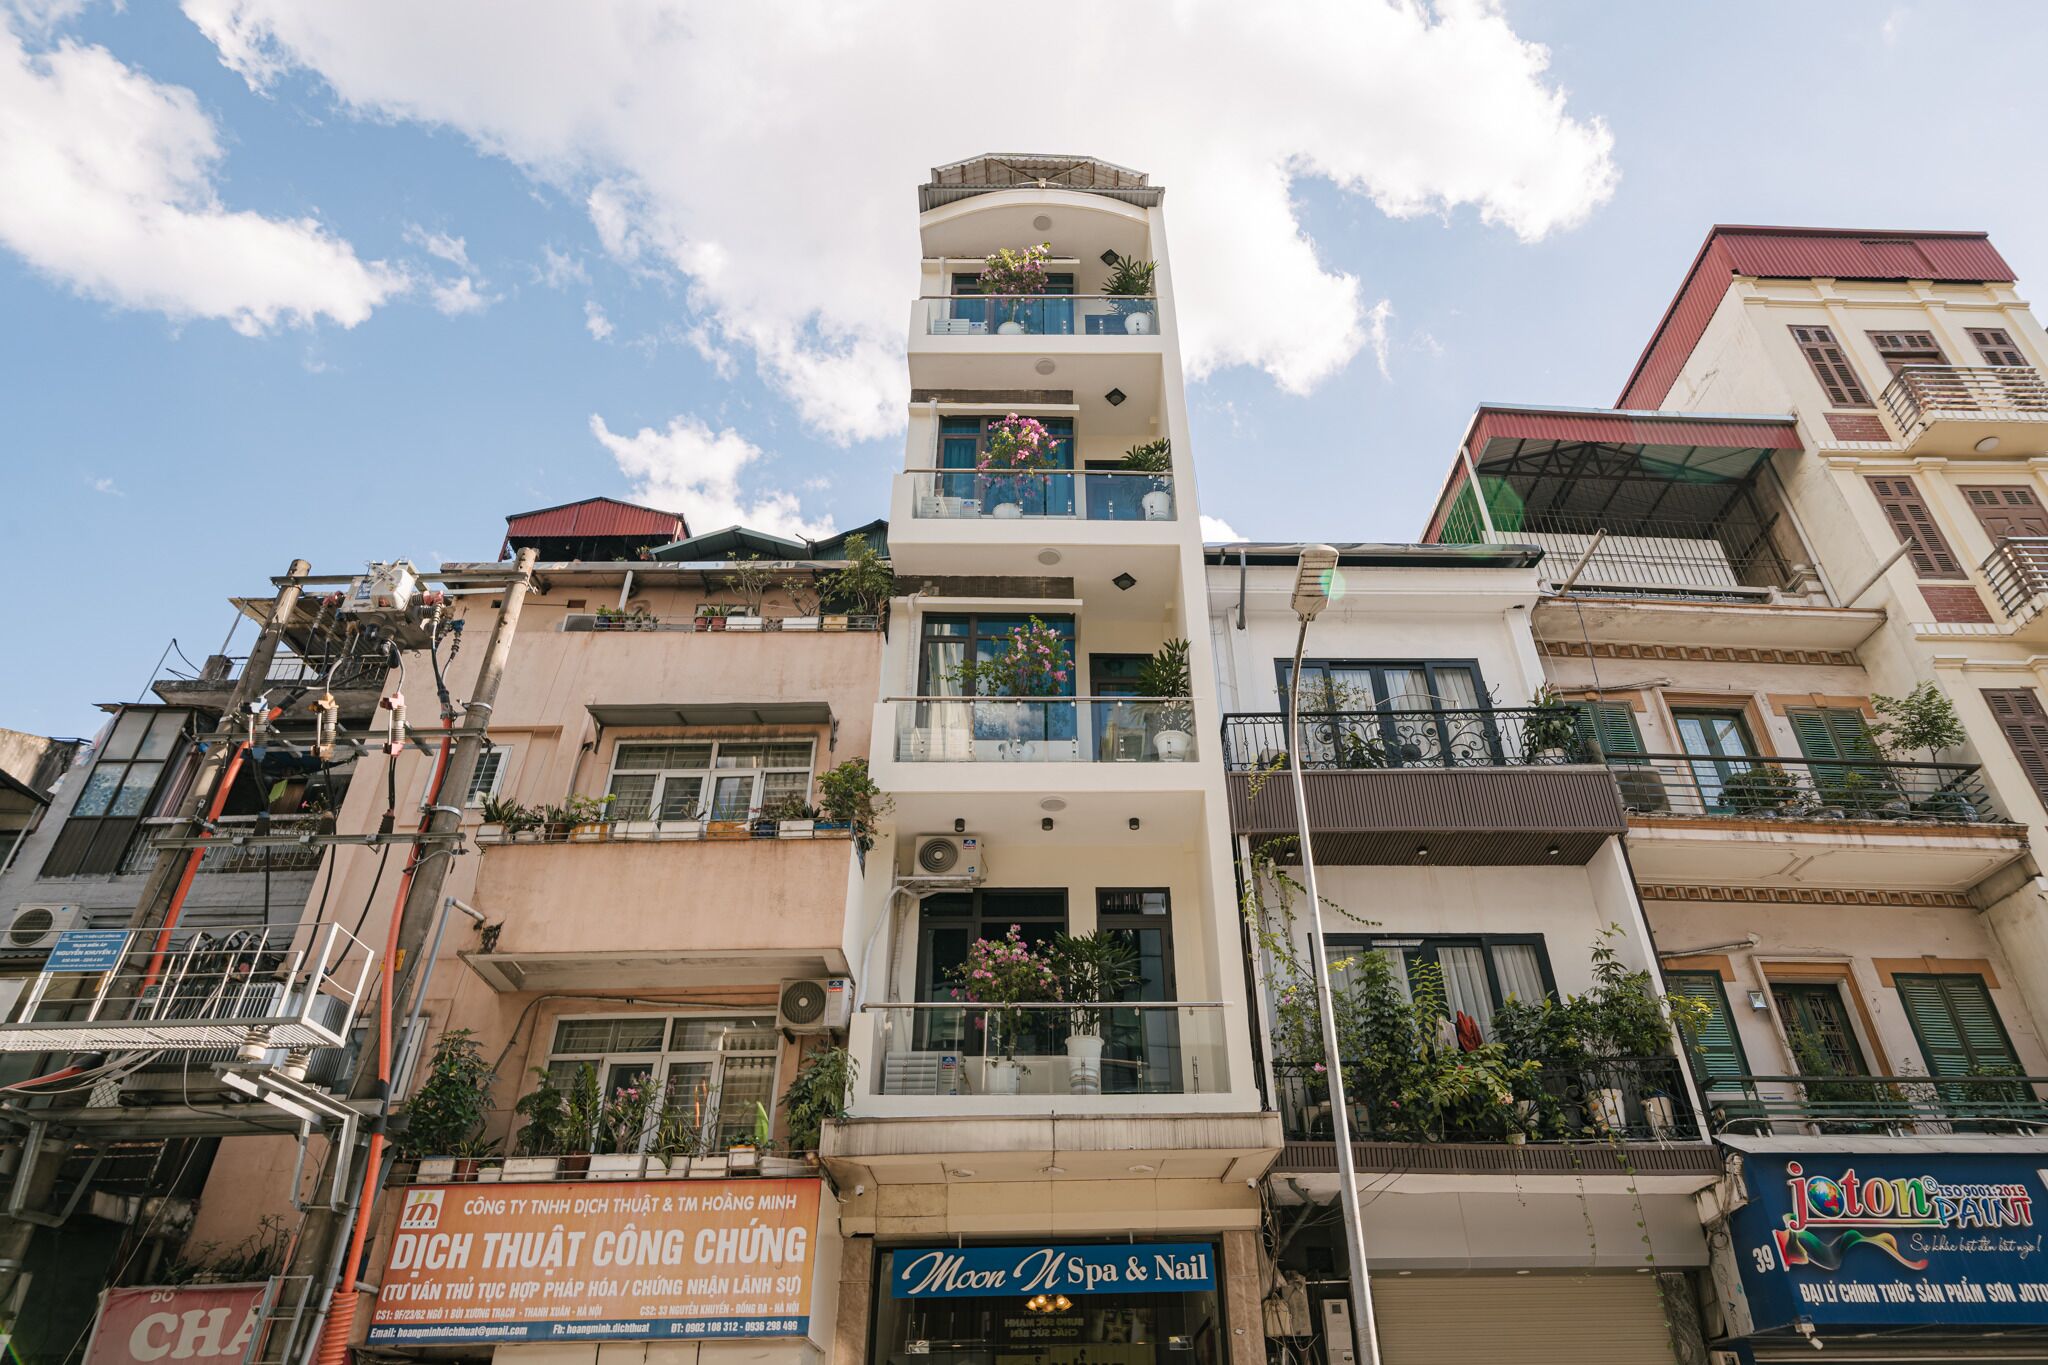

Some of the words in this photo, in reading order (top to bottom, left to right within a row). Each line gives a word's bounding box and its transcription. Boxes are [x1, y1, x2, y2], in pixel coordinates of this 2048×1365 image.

[1940, 1185, 1963, 1197] ISO
[1964, 1184, 2027, 1197] 9001:2015
[464, 1196, 506, 1216] CÔNG
[510, 1200, 527, 1215] TY
[531, 1199, 571, 1215] TNHH
[574, 1198, 609, 1217] DỊCH
[613, 1195, 659, 1216] THUẬT
[662, 1197, 673, 1212] &
[677, 1197, 698, 1212] TM
[702, 1193, 754, 1212] HOÀNG
[758, 1194, 797, 1210] MINH
[1932, 1197, 2034, 1228] PAINT
[390, 1233, 474, 1278] DỊCH
[482, 1224, 586, 1276] THUẬT
[592, 1223, 685, 1267] CÔNG
[693, 1218, 808, 1266] CHỨNG
[1752, 1244, 1776, 1273] 39
[902, 1251, 1006, 1294] Moon
[1067, 1256, 1119, 1291] Spa
[1125, 1256, 1148, 1281] &
[1154, 1254, 1208, 1281] Nail
[382, 1281, 411, 1303] (TƯ
[411, 1277, 440, 1301] VẤN
[445, 1276, 475, 1300] THỦ
[478, 1283, 506, 1303] TỤC
[508, 1281, 539, 1304] HỢP
[543, 1277, 586, 1298] PHÁP
[588, 1275, 618, 1297] HÓA
[632, 1275, 683, 1296] CHỨNG
[686, 1275, 729, 1298] NHẬN
[733, 1274, 772, 1295] LÃNH
[1799, 1283, 1824, 1306] ĐẠI
[1823, 1280, 1838, 1303] LÝ
[1839, 1280, 1880, 1303] CHÍNH
[1878, 1279, 1916, 1303] THỨC
[1915, 1277, 1946, 1303] SẢN
[1944, 1275, 1987, 1303] PHẨM
[1985, 1281, 2017, 1303] SƠN
[376, 1310, 393, 1321] CS1:
[524, 1306, 549, 1318] THANH
[549, 1305, 571, 1317] XUÂN
[576, 1305, 587, 1316] HÀ
[588, 1303, 603, 1318] NỘI
[639, 1305, 657, 1316] CS2:
[774, 1302, 785, 1314] HÀ
[369, 1328, 396, 1339] Email:
[552, 1324, 566, 1335] Fb:
[685, 1322, 705, 1333] 0902
[707, 1322, 722, 1333] 108
[723, 1321, 738, 1332] 312
[745, 1321, 765, 1332] 0936
[766, 1320, 782, 1331] 298
[783, 1320, 798, 1331] 499
